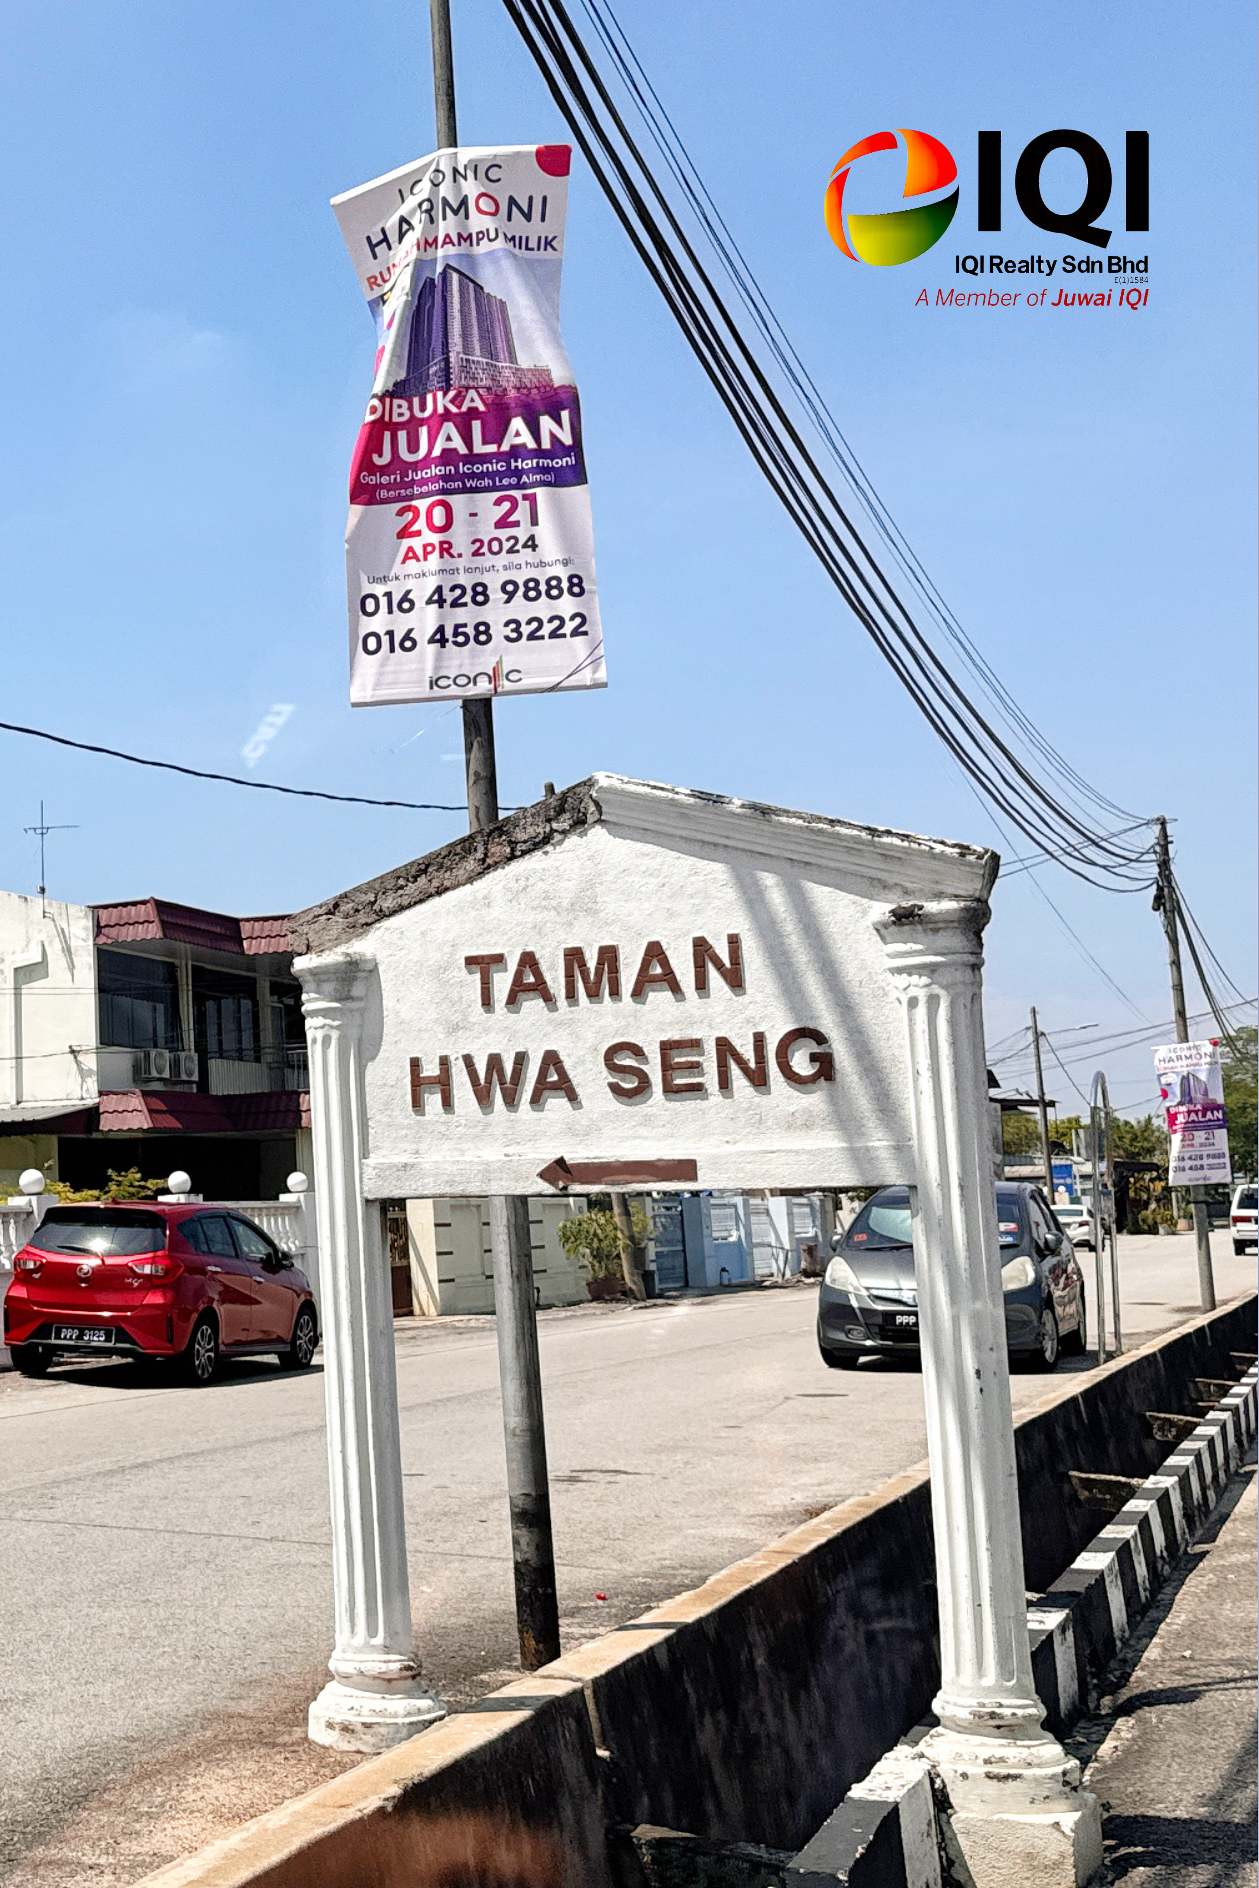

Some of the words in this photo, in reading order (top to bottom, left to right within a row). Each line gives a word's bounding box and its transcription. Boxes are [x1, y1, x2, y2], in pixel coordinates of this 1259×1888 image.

[398, 164, 503, 204] ICONIC
[366, 192, 548, 260] HARMONI
[423, 227, 499, 252] MAMPU
[503, 230, 558, 251] MILIK
[365, 388, 486, 424] DIBUKA
[372, 409, 573, 466] JUALAN
[360, 468, 401, 485] Galeri
[404, 464, 455, 482] Jualan
[460, 458, 507, 474] Iconic
[511, 451, 576, 471] Harmoni
[465, 474, 493, 488] Wah
[520, 471, 555, 484] Alma)
[395, 498, 454, 540] 20
[493, 492, 540, 530] 21
[400, 539, 463, 565] APR.
[471, 534, 538, 558] 2024
[367, 569, 402, 585] Untuk
[404, 563, 460, 581] maklumat
[463, 562, 500, 577] lanjut,
[502, 560, 522, 571] sila
[525, 555, 575, 570] hubungi:
[359, 589, 416, 617] 016
[425, 582, 490, 610] 428
[500, 573, 586, 605] 9888
[361, 627, 418, 656] 016
[427, 621, 492, 649] 458
[503, 612, 589, 644] 3222
[464, 933, 744, 1010] TAMAN
[409, 1050, 580, 1112] HWA
[603, 1027, 835, 1102] SENG
[1158, 1051, 1216, 1065] HARMONI
[1175, 1110, 1224, 1125] JUALAN
[61, 1328, 79, 1339] PPP
[83, 1330, 106, 1341] 3125
[895, 1315, 917, 1326] PPP
